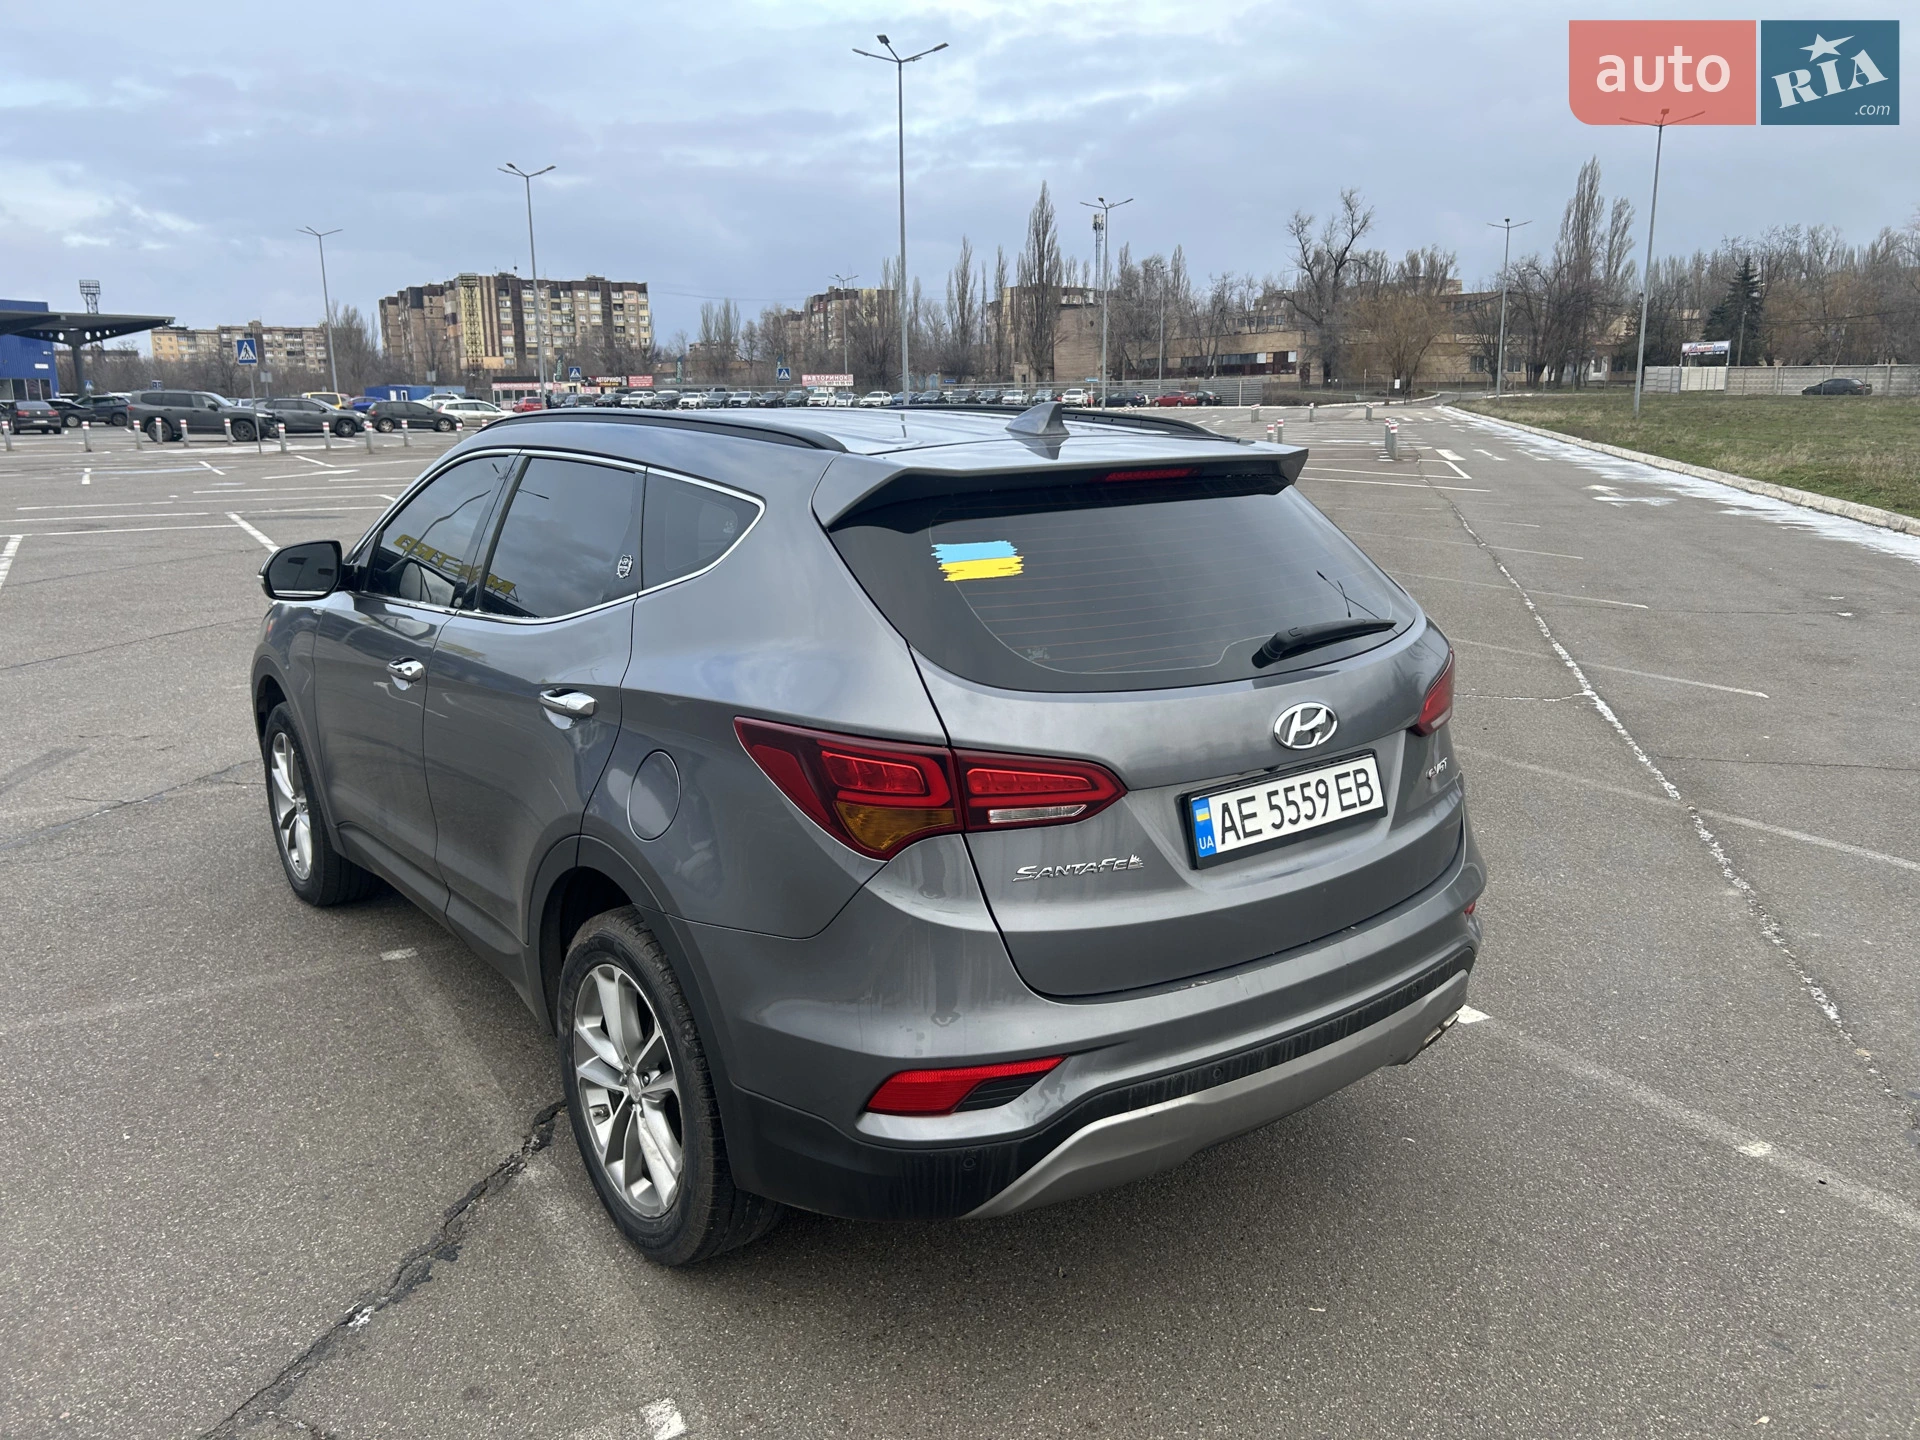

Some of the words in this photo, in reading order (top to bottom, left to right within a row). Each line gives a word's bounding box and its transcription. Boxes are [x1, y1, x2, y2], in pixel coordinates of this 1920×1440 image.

[1220, 795, 1264, 845] AE
[1266, 778, 1330, 830] 5559
[1334, 767, 1375, 812] EB
[1198, 836, 1215, 851] UA
